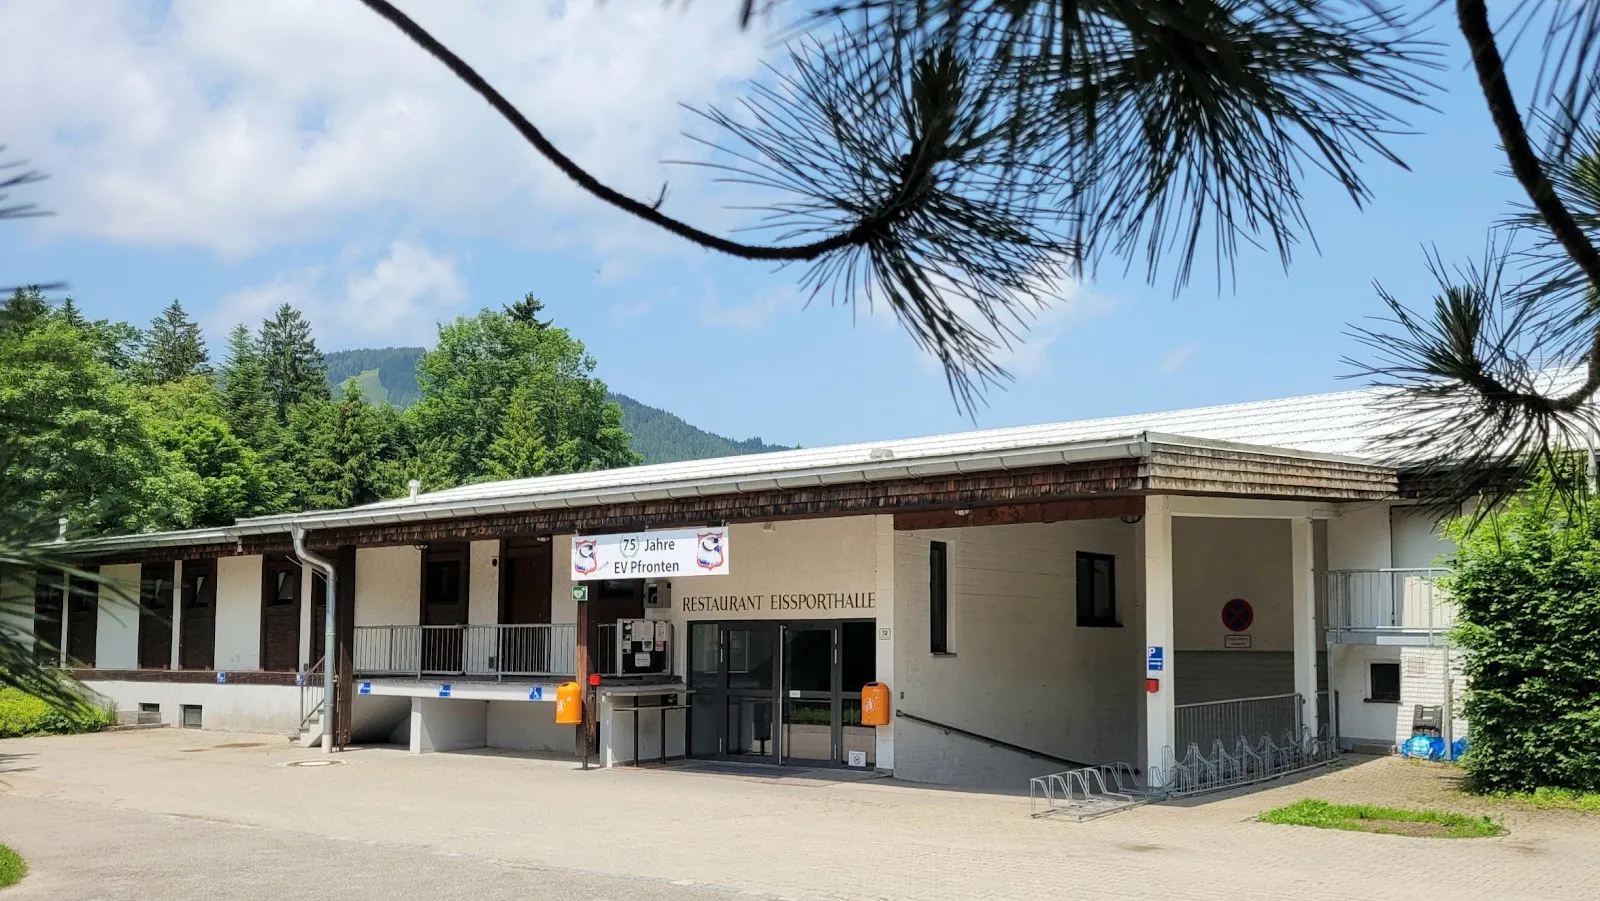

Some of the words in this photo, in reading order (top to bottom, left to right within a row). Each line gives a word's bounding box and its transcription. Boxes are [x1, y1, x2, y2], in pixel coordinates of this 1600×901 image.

[623, 539, 636, 551] 75
[644, 538, 675, 551] Jahre
[614, 561, 628, 574] EV
[630, 560, 680, 574] Pfronten
[682, 595, 764, 612] RESTAURANT
[770, 592, 876, 611] EISSPORTHALLE
[1148, 647, 1156, 657] P
